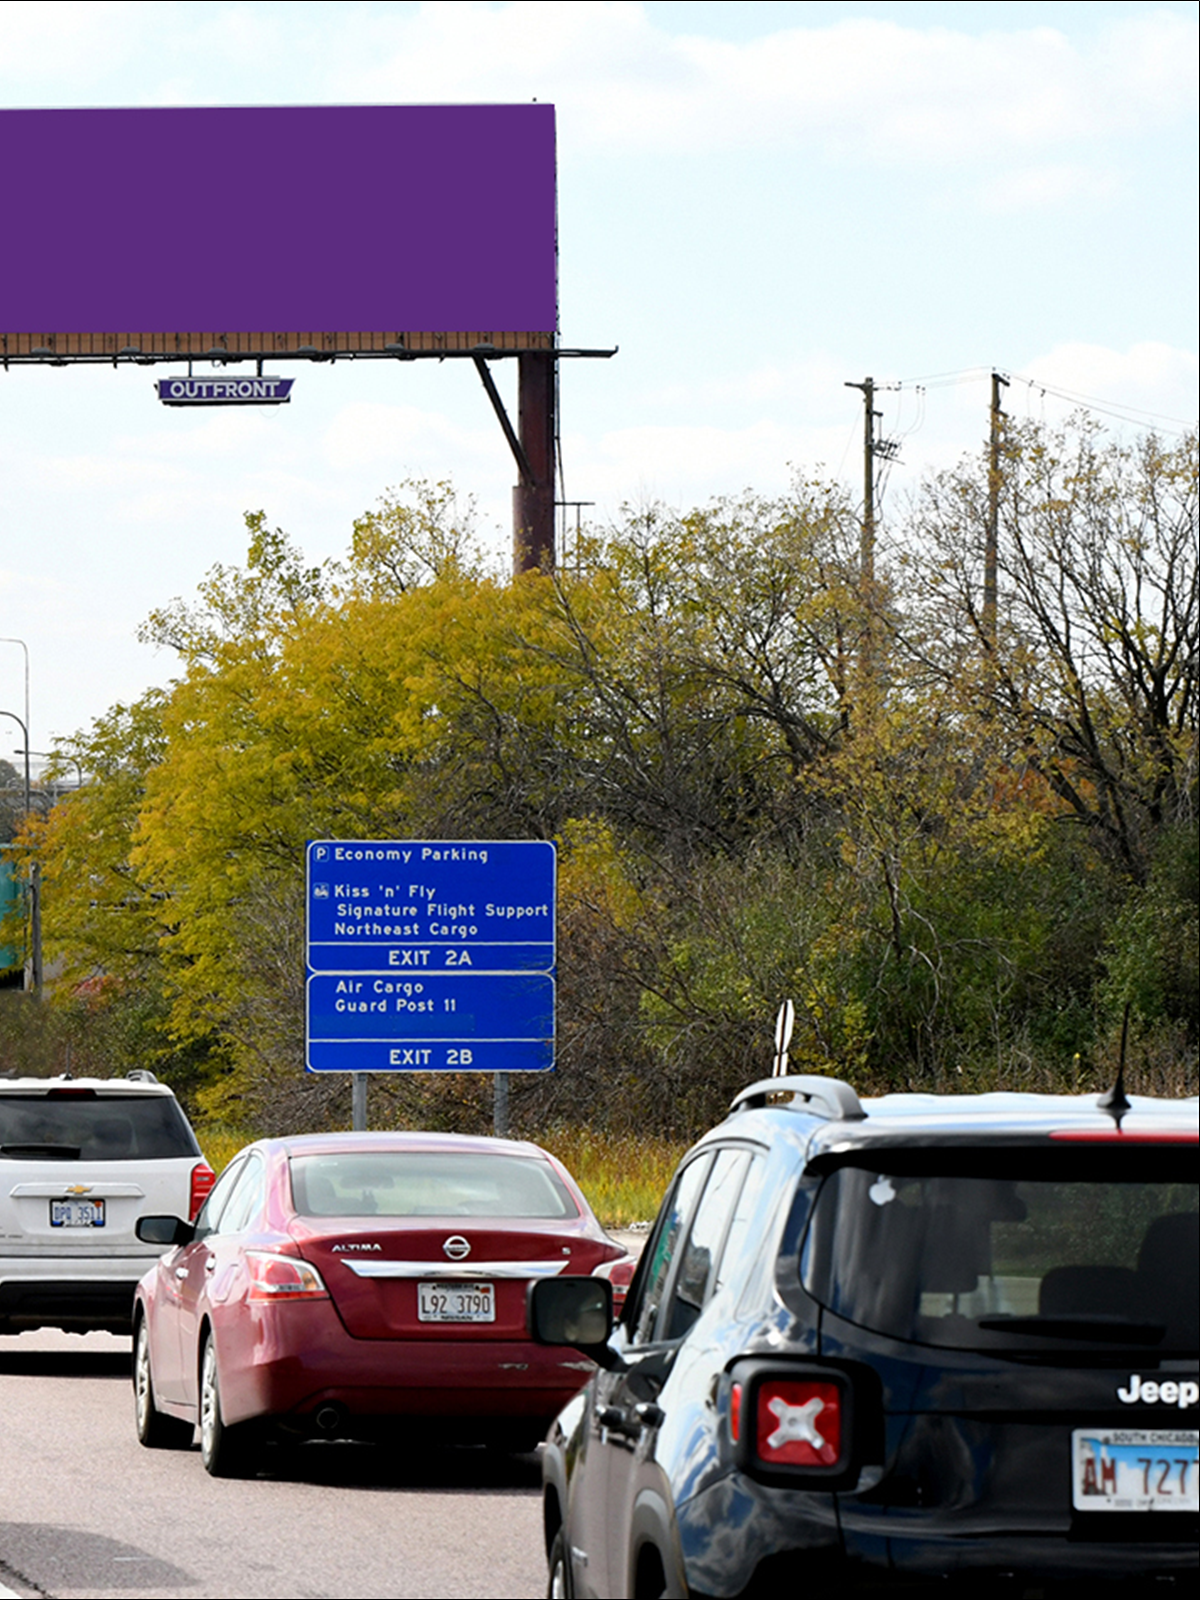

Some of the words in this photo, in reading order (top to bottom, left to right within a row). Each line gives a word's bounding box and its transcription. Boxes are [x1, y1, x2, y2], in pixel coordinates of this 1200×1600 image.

[170, 381, 280, 397] OUTFRONT
[335, 848, 411, 863] Economy
[422, 848, 488, 864] Parking
[334, 885, 370, 898] Kiss
[409, 885, 436, 900] Fly
[337, 903, 418, 920] Signature
[427, 903, 475, 920] Flight
[485, 903, 548, 920] Support
[334, 922, 419, 936] Northeast
[429, 922, 478, 938] Cargo
[388, 950, 430, 966] EXIT
[445, 950, 472, 966] 2A
[336, 980, 363, 994] Air
[373, 980, 424, 996] Cargo
[335, 999, 387, 1012] Guard
[396, 999, 434, 1012] Post
[444, 999, 456, 1012] 11
[389, 1049, 431, 1065] EXIT
[446, 1049, 473, 1065] 2B
[331, 1243, 383, 1252] ALTIMA
[421, 1295, 448, 1314] L92
[456, 1295, 491, 1314] 3790
[1117, 1374, 1199, 1409] Jeep
[1113, 1431, 1146, 1443] SOUTH
[1137, 1457, 1199, 1495] 727
